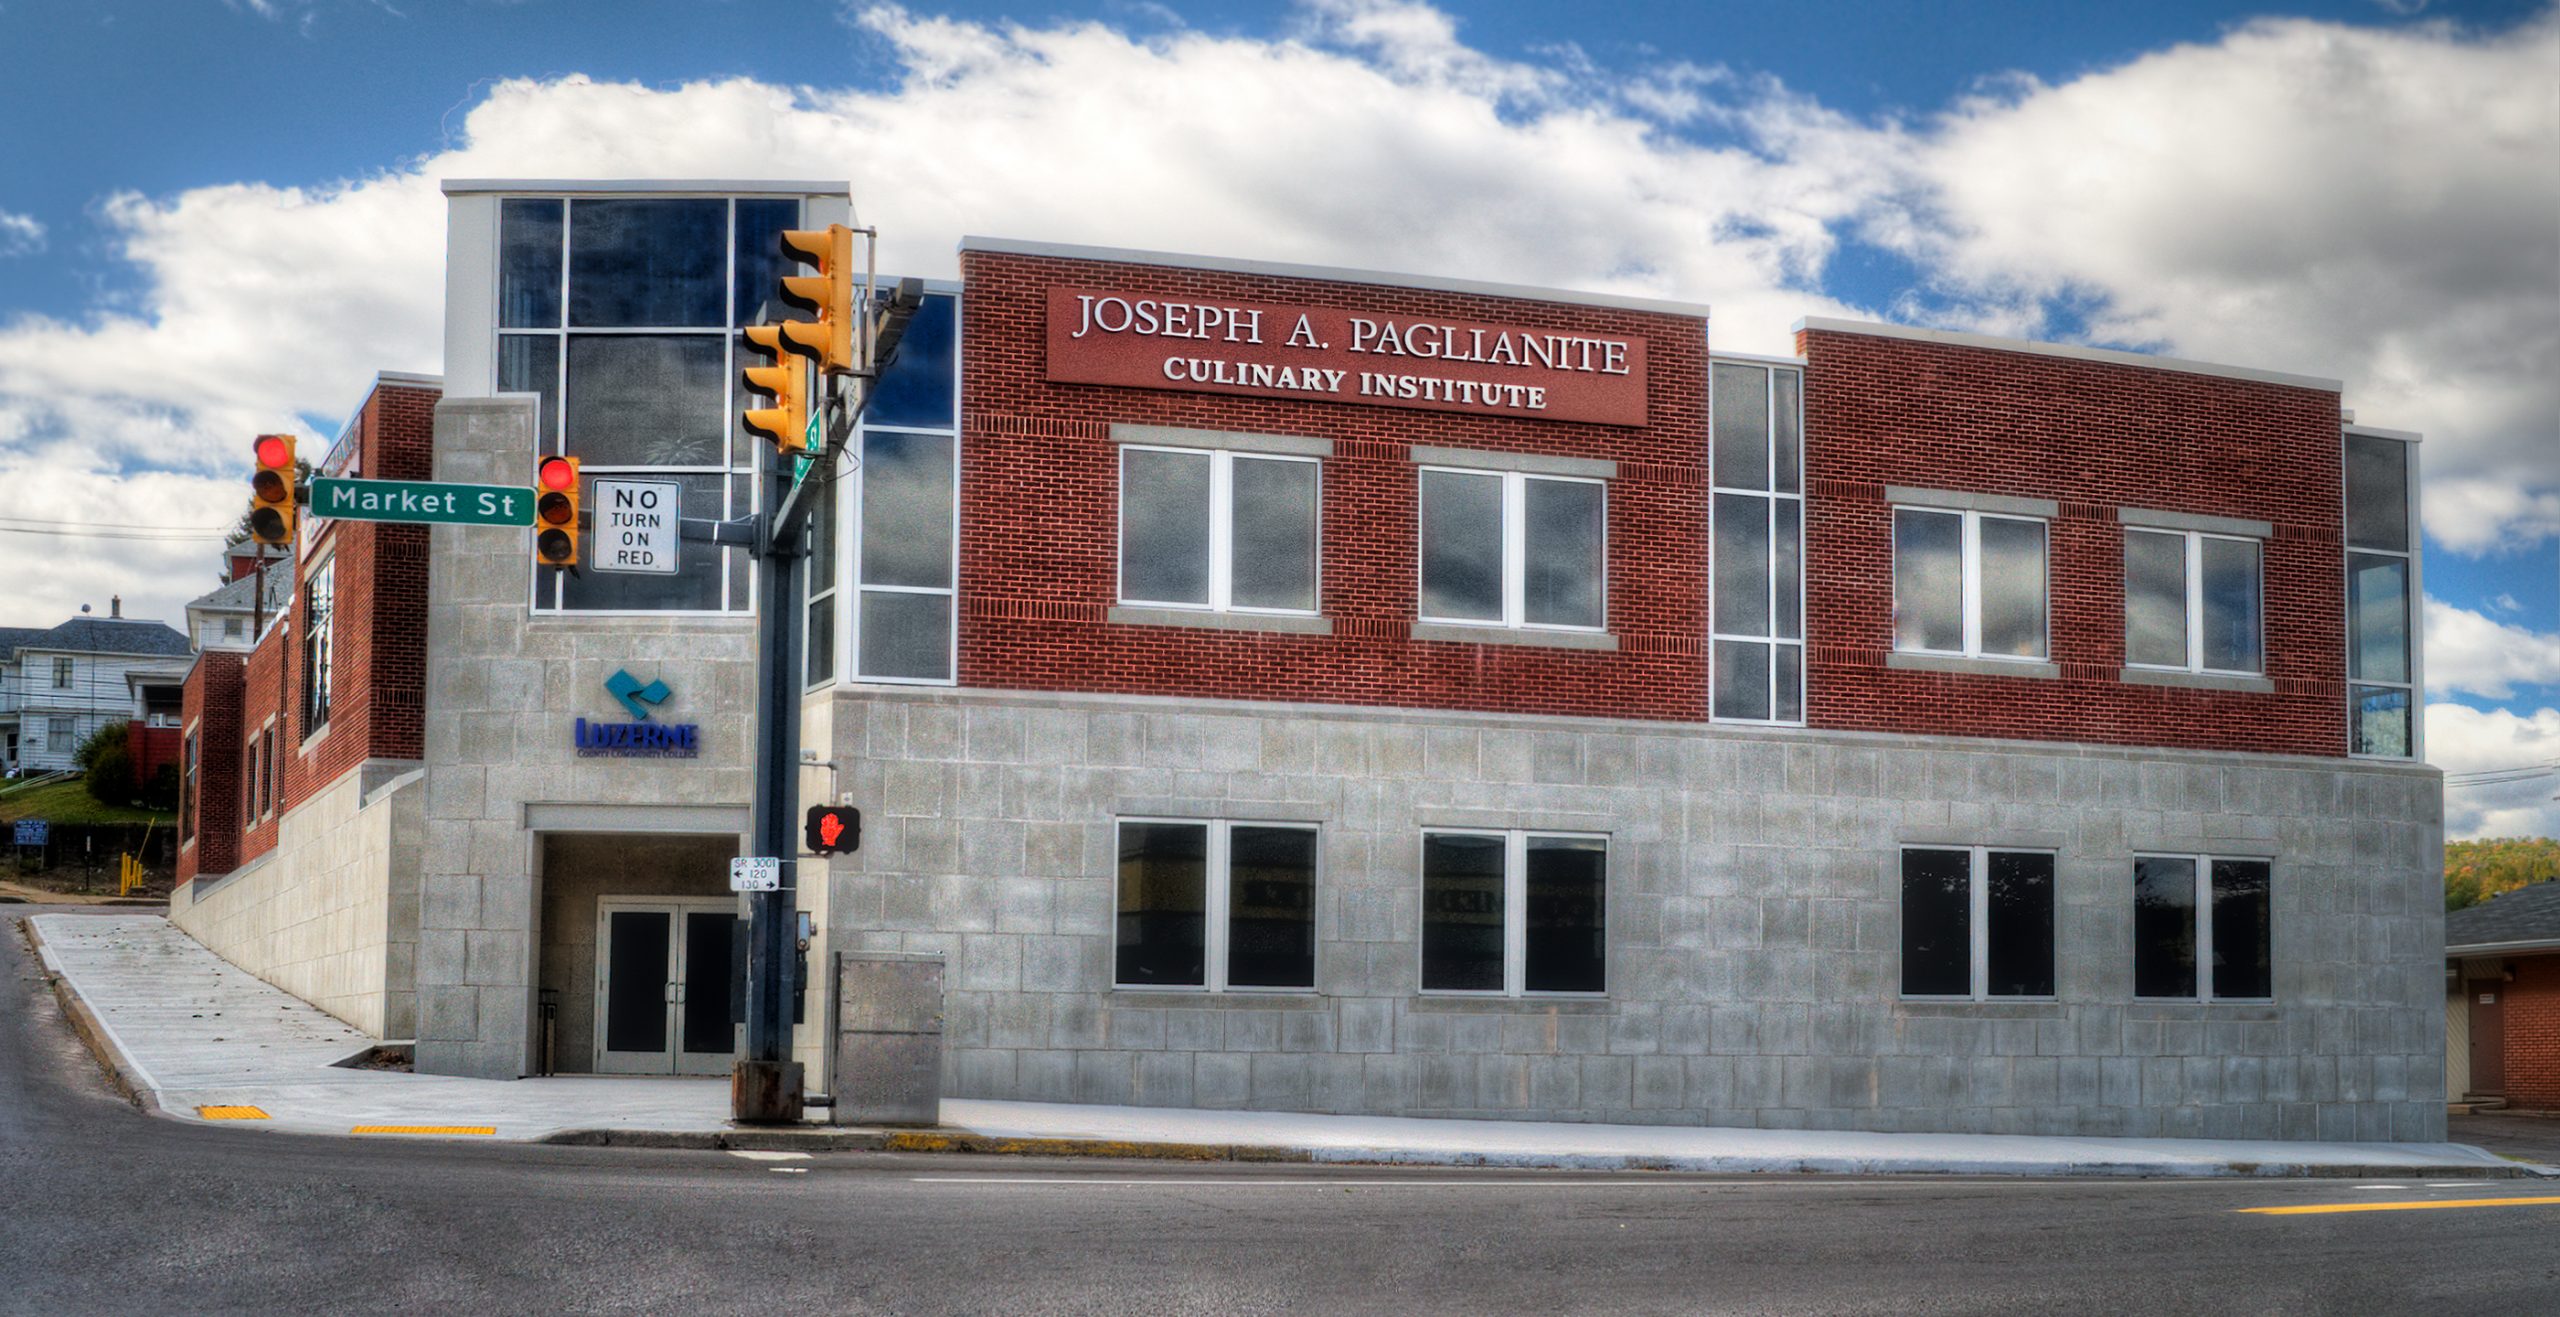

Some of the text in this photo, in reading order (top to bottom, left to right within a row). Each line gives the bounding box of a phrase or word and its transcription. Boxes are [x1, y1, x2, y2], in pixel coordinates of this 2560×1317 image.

[1072, 294, 1631, 376] JOSEPH A. PAGLIANITE
[1163, 356, 1547, 410] CULINARY INSTITUTE
[332, 485, 515, 517] Market St
[615, 488, 658, 510] NO
[611, 512, 660, 528] TURN
[622, 531, 649, 547] ON
[617, 550, 654, 566] RED
[576, 718, 698, 748] LUZERNE
[735, 858, 776, 868] SR 3001
[750, 869, 767, 878] 120
[741, 880, 759, 889] 130
